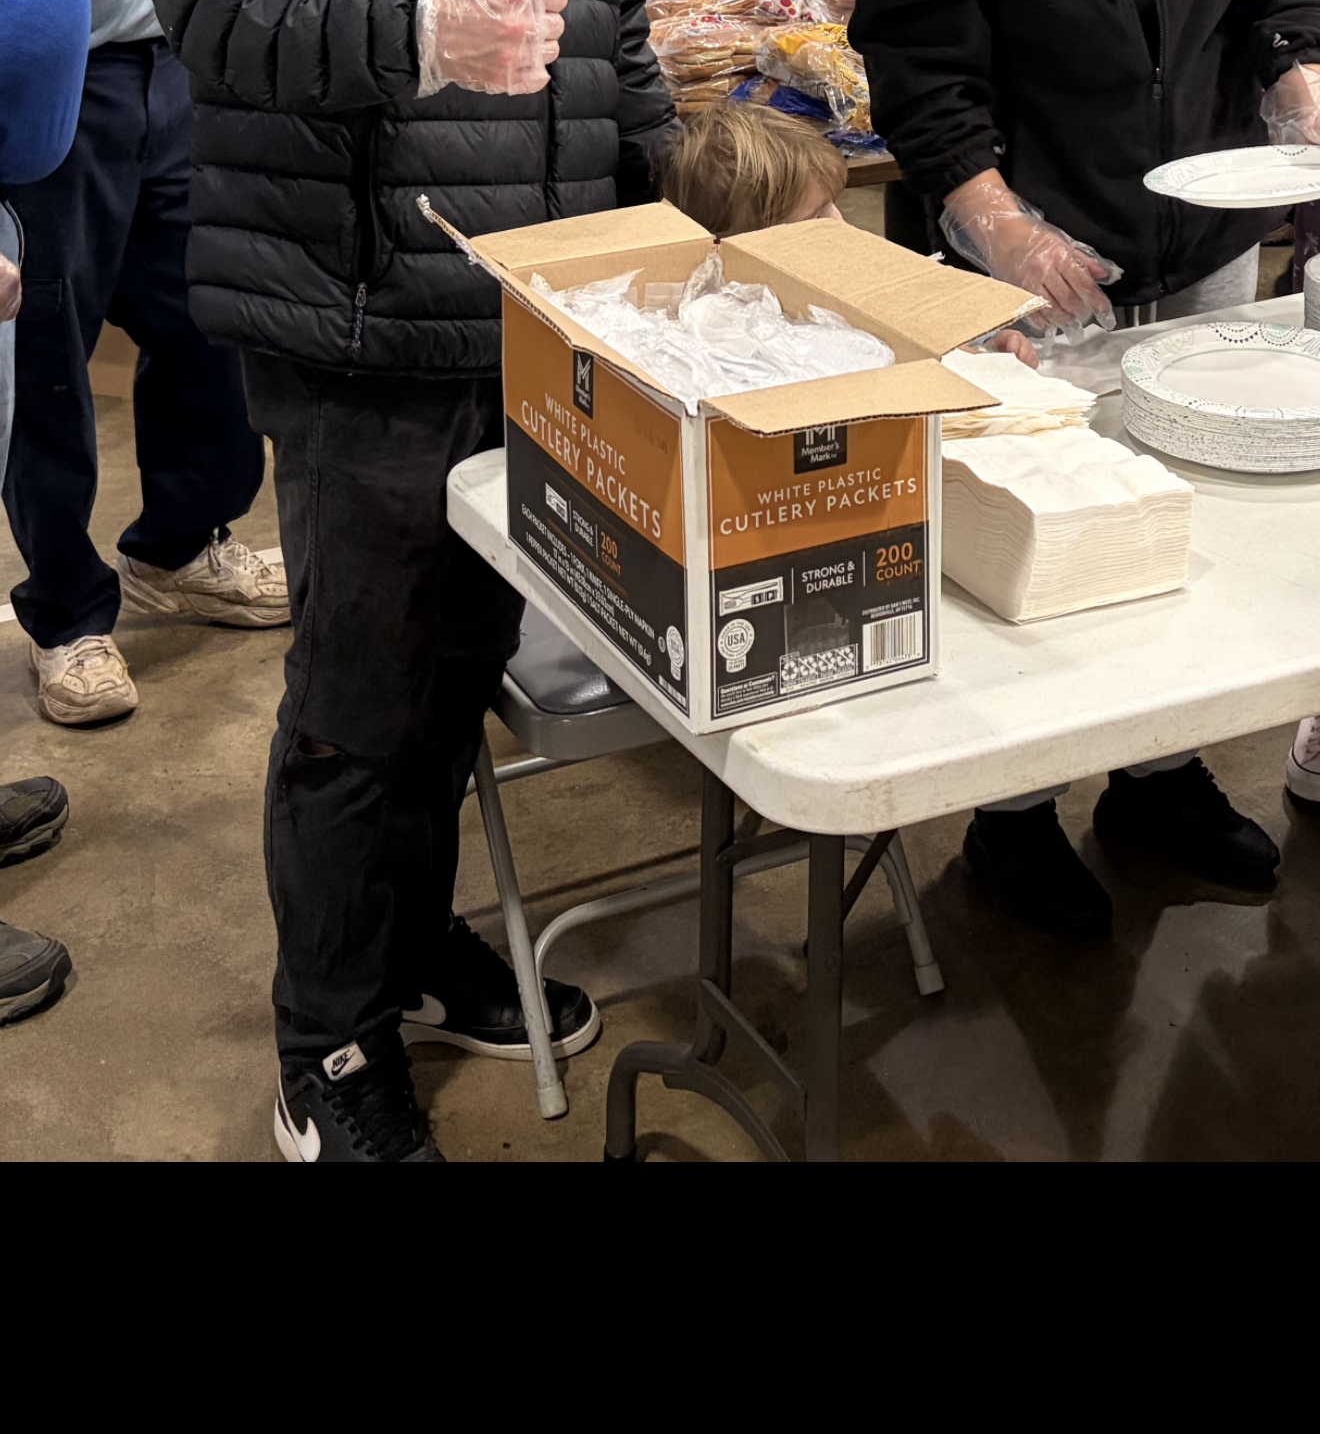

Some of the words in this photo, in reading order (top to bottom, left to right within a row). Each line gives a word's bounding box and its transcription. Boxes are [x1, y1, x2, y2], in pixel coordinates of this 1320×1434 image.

[545, 393, 577, 435] WHITE
[581, 424, 626, 475] PLASTIC
[801, 441, 839, 456] Member's
[522, 400, 581, 471] CUTLERY
[587, 457, 661, 538] PACKETS
[757, 483, 811, 505] WHITE
[818, 467, 881, 493] PLASTIC
[720, 499, 816, 535] CUTLERY
[827, 477, 917, 512] PACKETS
[601, 532, 618, 559] 200
[876, 542, 913, 567] 200
[601, 552, 621, 575] COUNT
[801, 563, 845, 582] STRONG
[847, 561, 855, 572] &
[876, 560, 921, 581] COUNT
[806, 573, 853, 594] DURABLE
[727, 632, 745, 647] USA
[333, 1048, 350, 1068] NIKE
